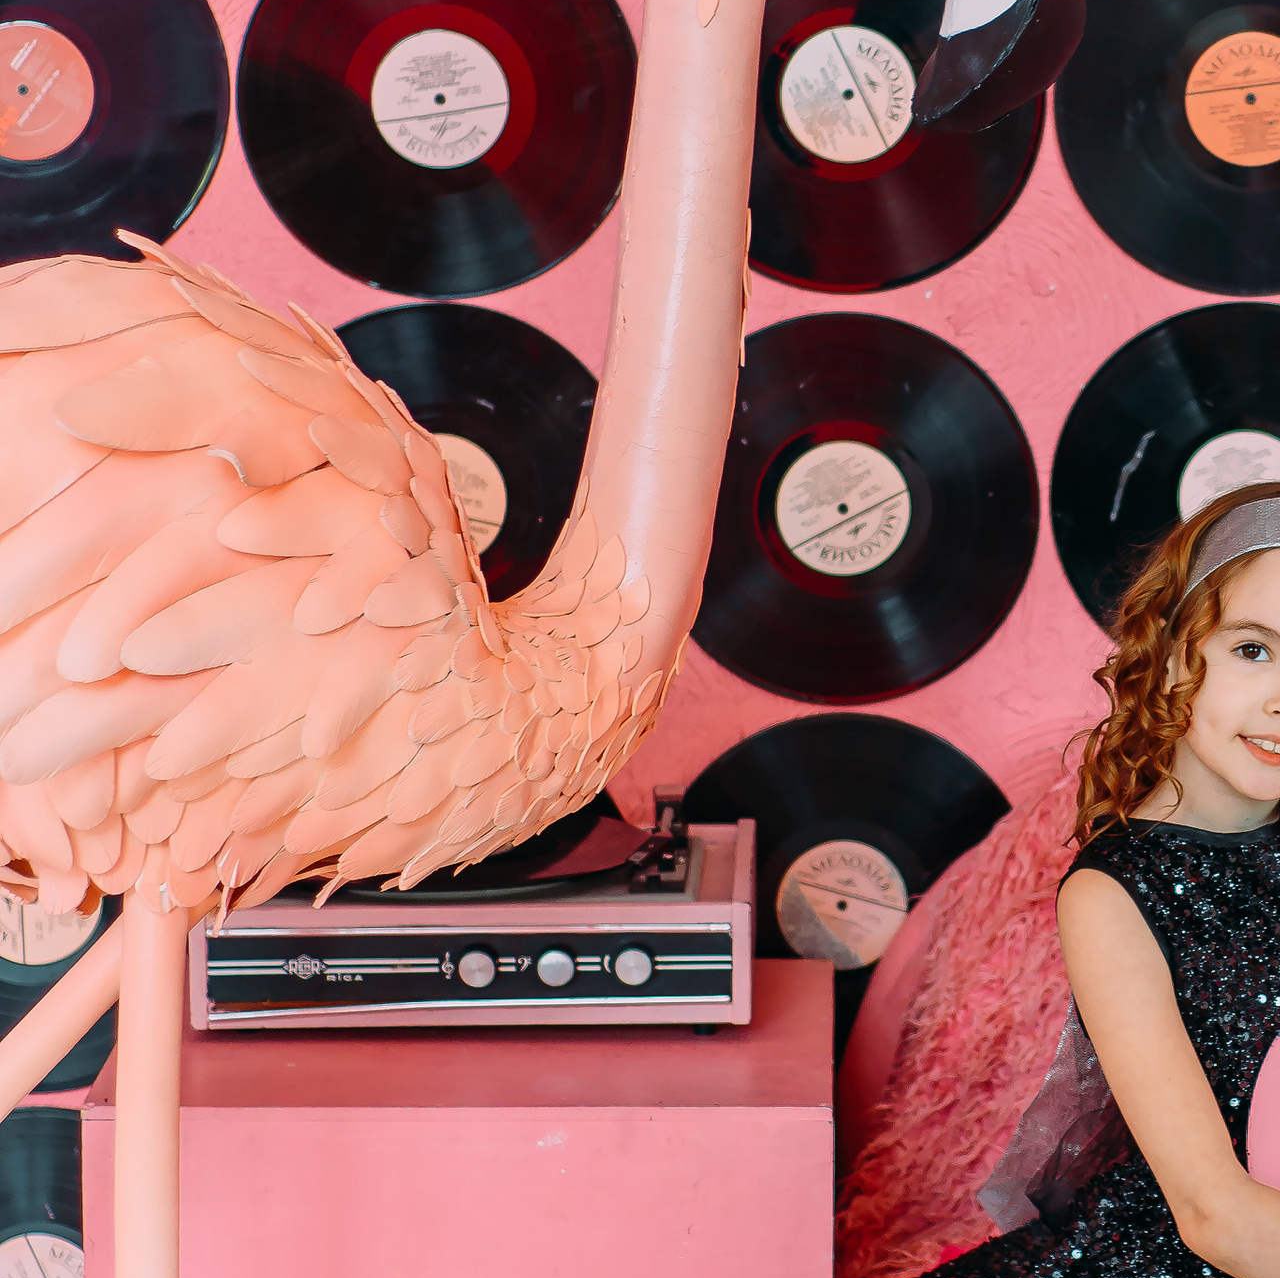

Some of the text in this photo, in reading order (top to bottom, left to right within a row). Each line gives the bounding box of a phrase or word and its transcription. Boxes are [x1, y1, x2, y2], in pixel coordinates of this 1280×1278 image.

[856, 41, 905, 122] МЕЛОДИЯ
[819, 512, 897, 562] МЕЛОДИЯ
[810, 848, 893, 896] МЕЛОДИЯ
